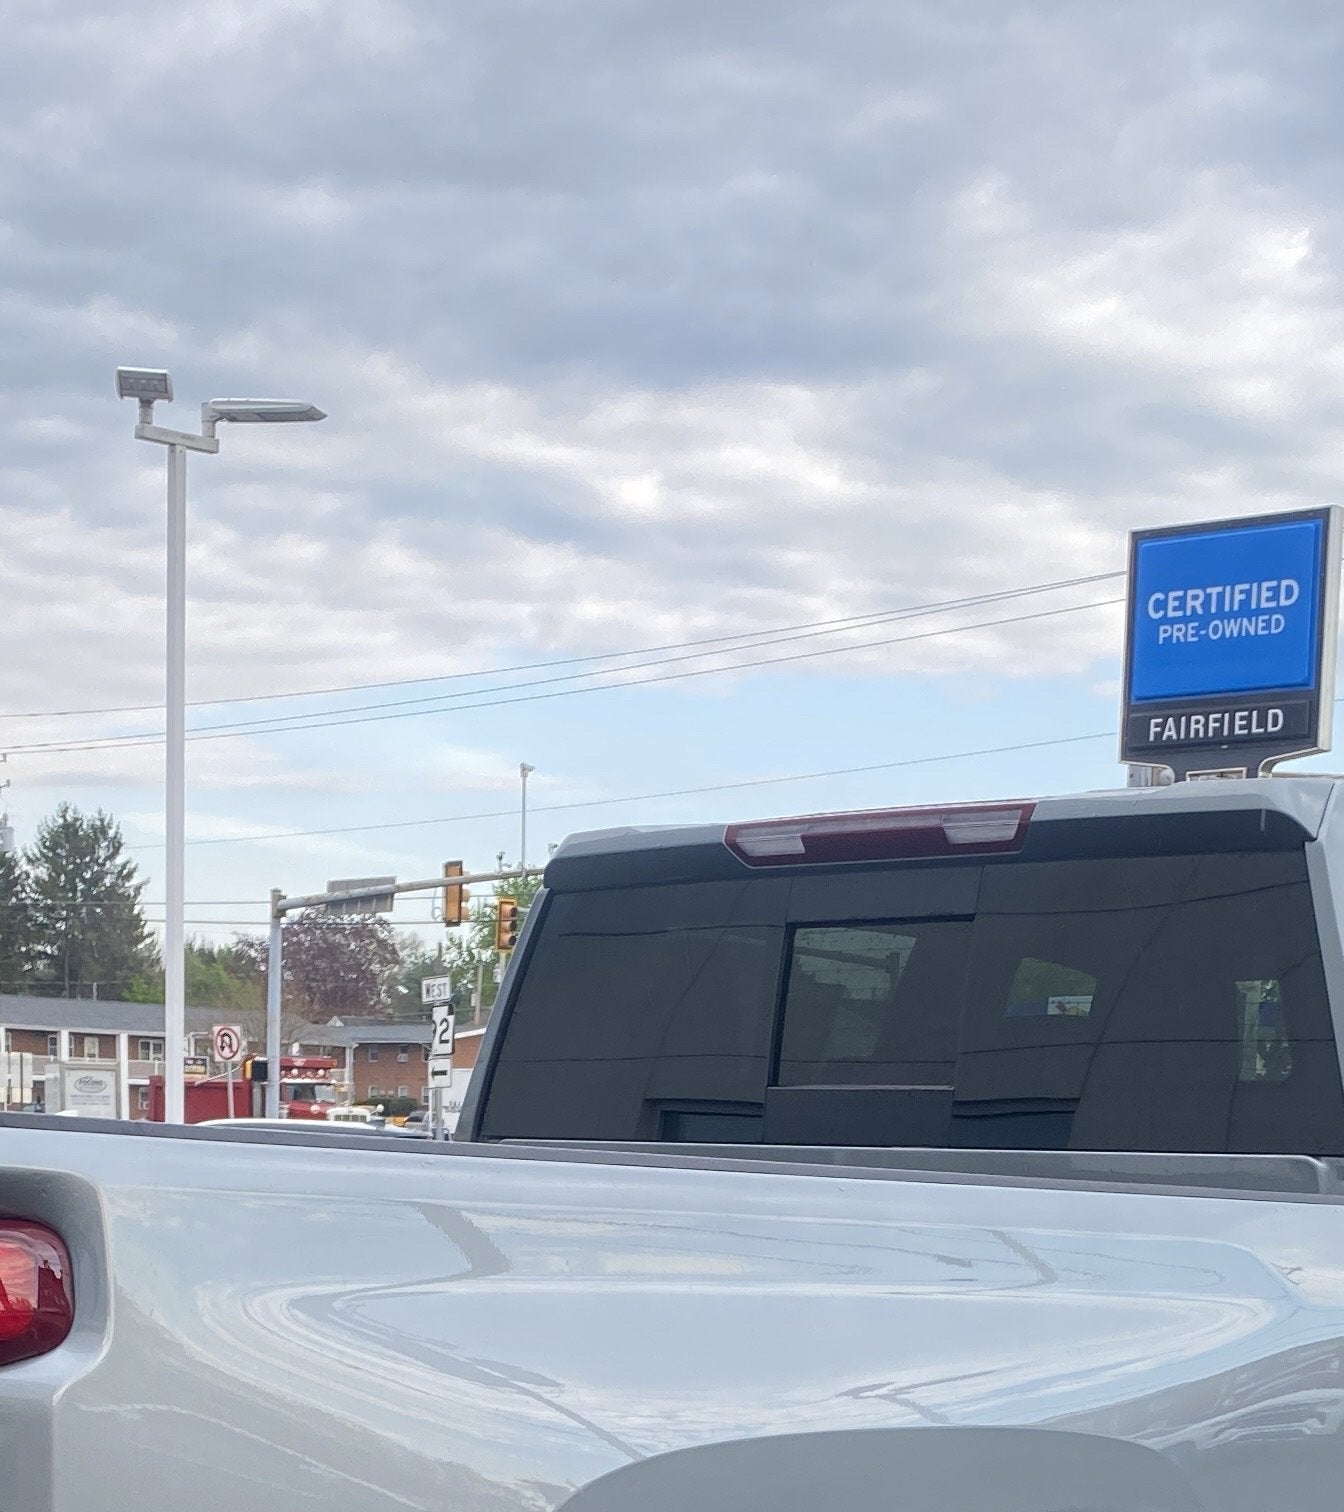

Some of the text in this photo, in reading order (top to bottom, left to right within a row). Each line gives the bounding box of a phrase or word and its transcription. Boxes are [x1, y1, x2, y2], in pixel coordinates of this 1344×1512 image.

[1147, 578, 1300, 620] CERTIFIED
[1158, 613, 1286, 645] PRE-OWNED
[1148, 708, 1284, 741] FAIRFIELD
[424, 982, 448, 999] WEST
